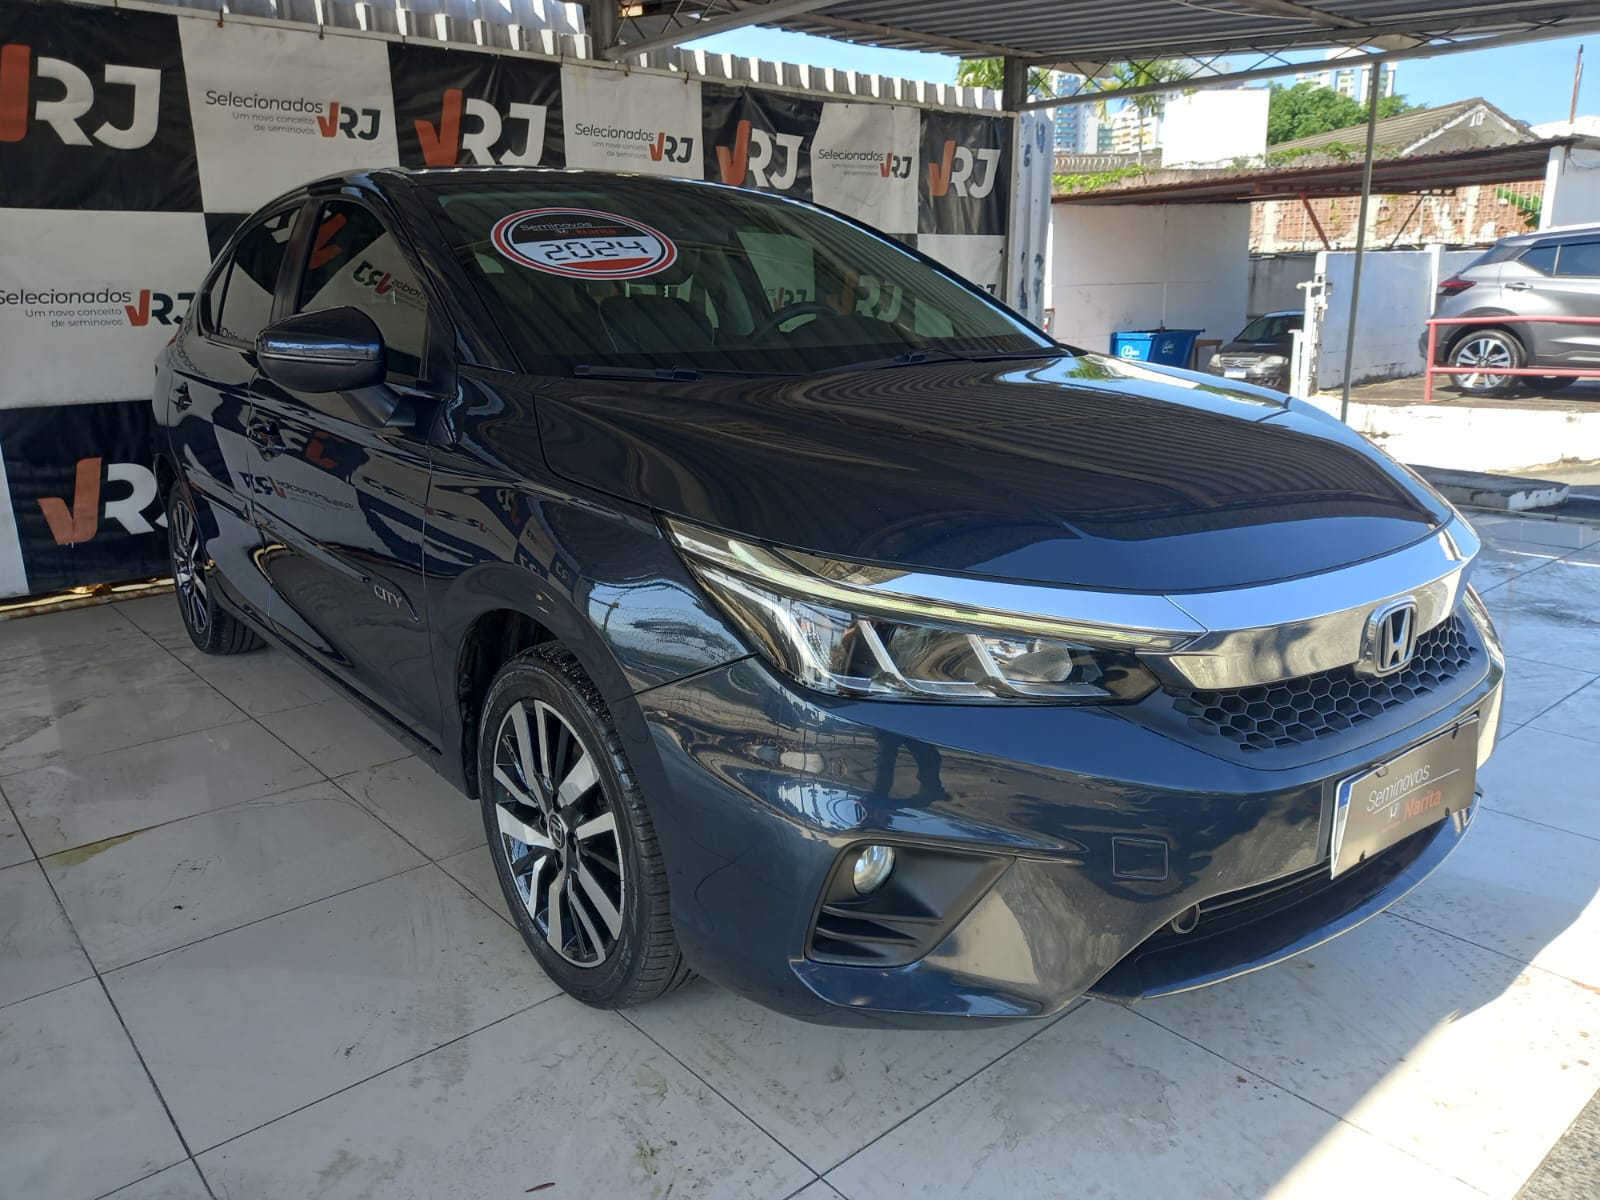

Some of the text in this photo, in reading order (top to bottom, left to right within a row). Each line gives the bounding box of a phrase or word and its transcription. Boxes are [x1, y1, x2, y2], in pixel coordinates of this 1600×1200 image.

[206, 90, 324, 114] Selecionados
[232, 112, 250, 120] Um
[253, 123, 266, 132] de
[317, 102, 381, 140] VRJ
[414, 88, 547, 167] VRJ
[575, 123, 655, 142] Selecionados
[649, 132, 694, 163] VRJ
[716, 120, 804, 189] VRJ
[819, 149, 884, 162] Selecionados
[880, 152, 913, 179] VRJ
[928, 139, 1002, 199] VRJ
[538, 241, 649, 260] 2024
[25, 308, 122, 318] Um novo conceito
[51, 318, 124, 328] de seminovos
[37, 457, 168, 544] VR
[374, 584, 402, 608] CITY
[1366, 764, 1430, 812] Seminovos
[1404, 790, 1442, 820] Narita
